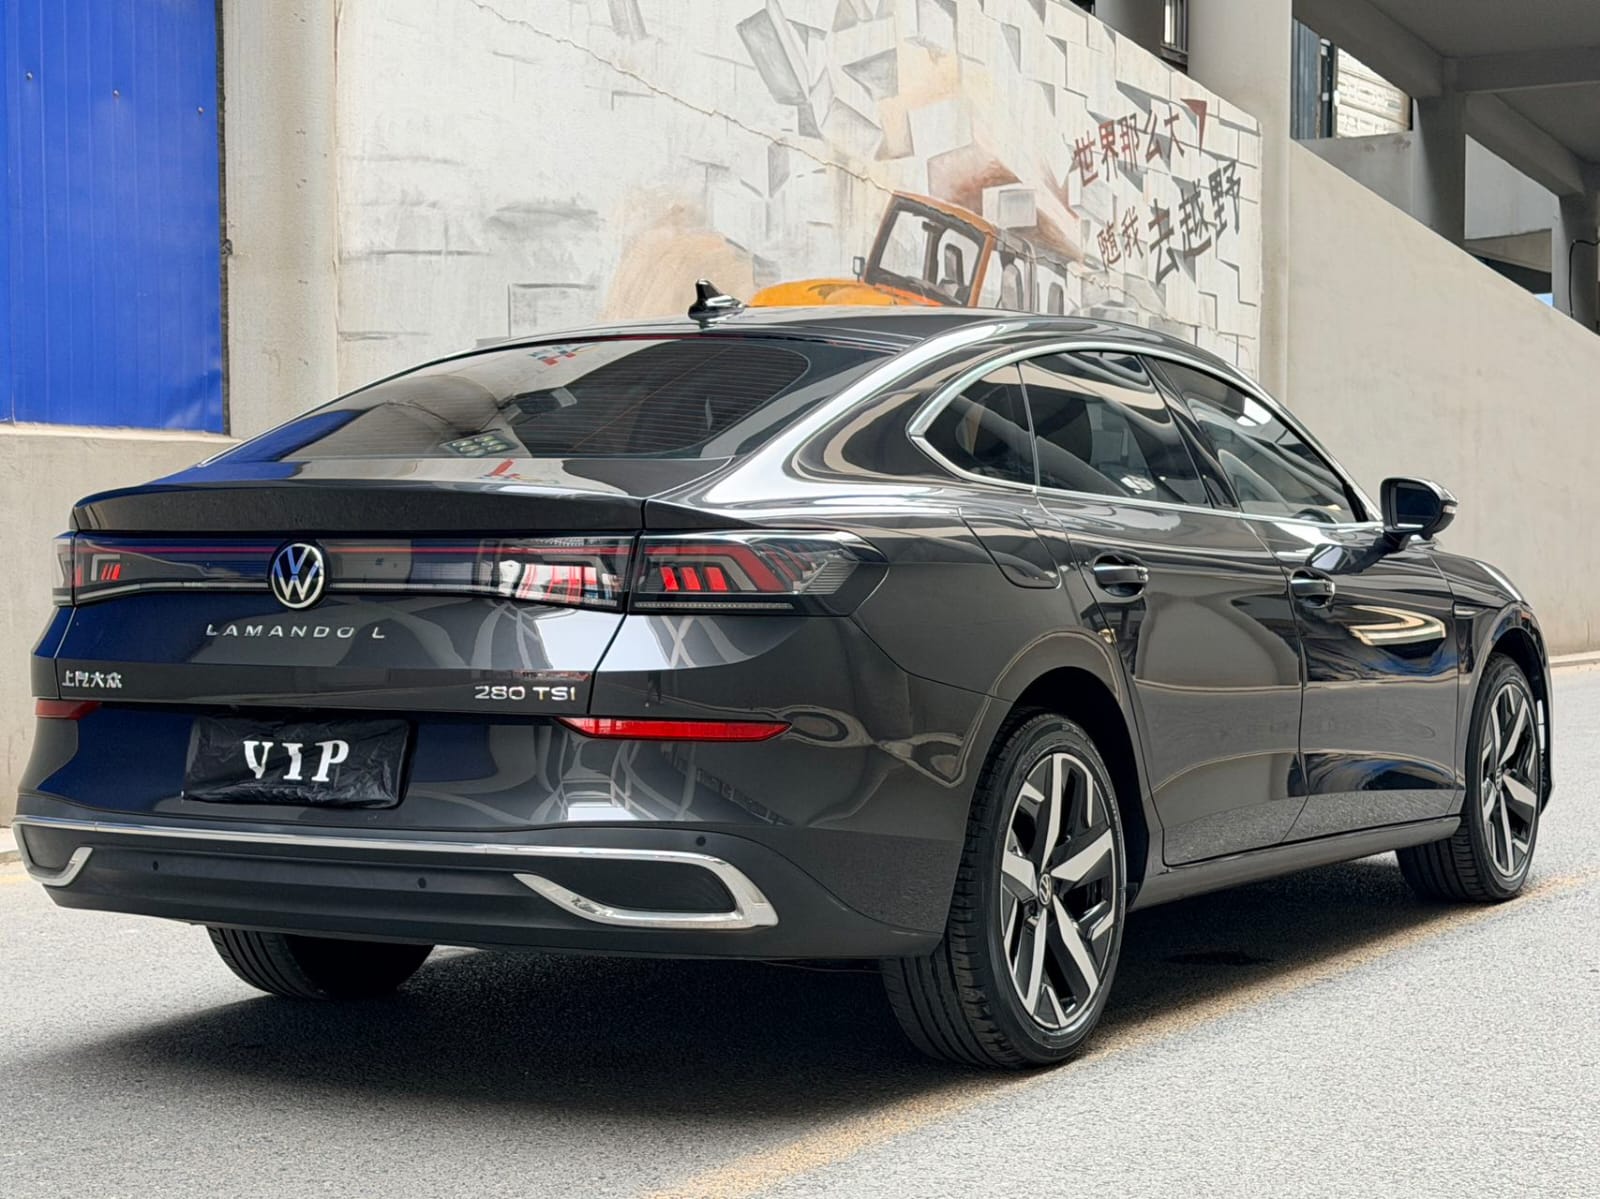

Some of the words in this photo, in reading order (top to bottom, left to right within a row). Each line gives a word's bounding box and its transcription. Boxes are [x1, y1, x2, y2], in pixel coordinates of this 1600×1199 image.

[1073, 108, 1185, 187] 世界那么大
[1096, 160, 1242, 286] 随我去越野
[205, 623, 355, 639] LAMANDO
[371, 626, 386, 640] L
[474, 685, 526, 700] 280
[532, 685, 576, 701] TSI
[242, 739, 350, 782] VIP
